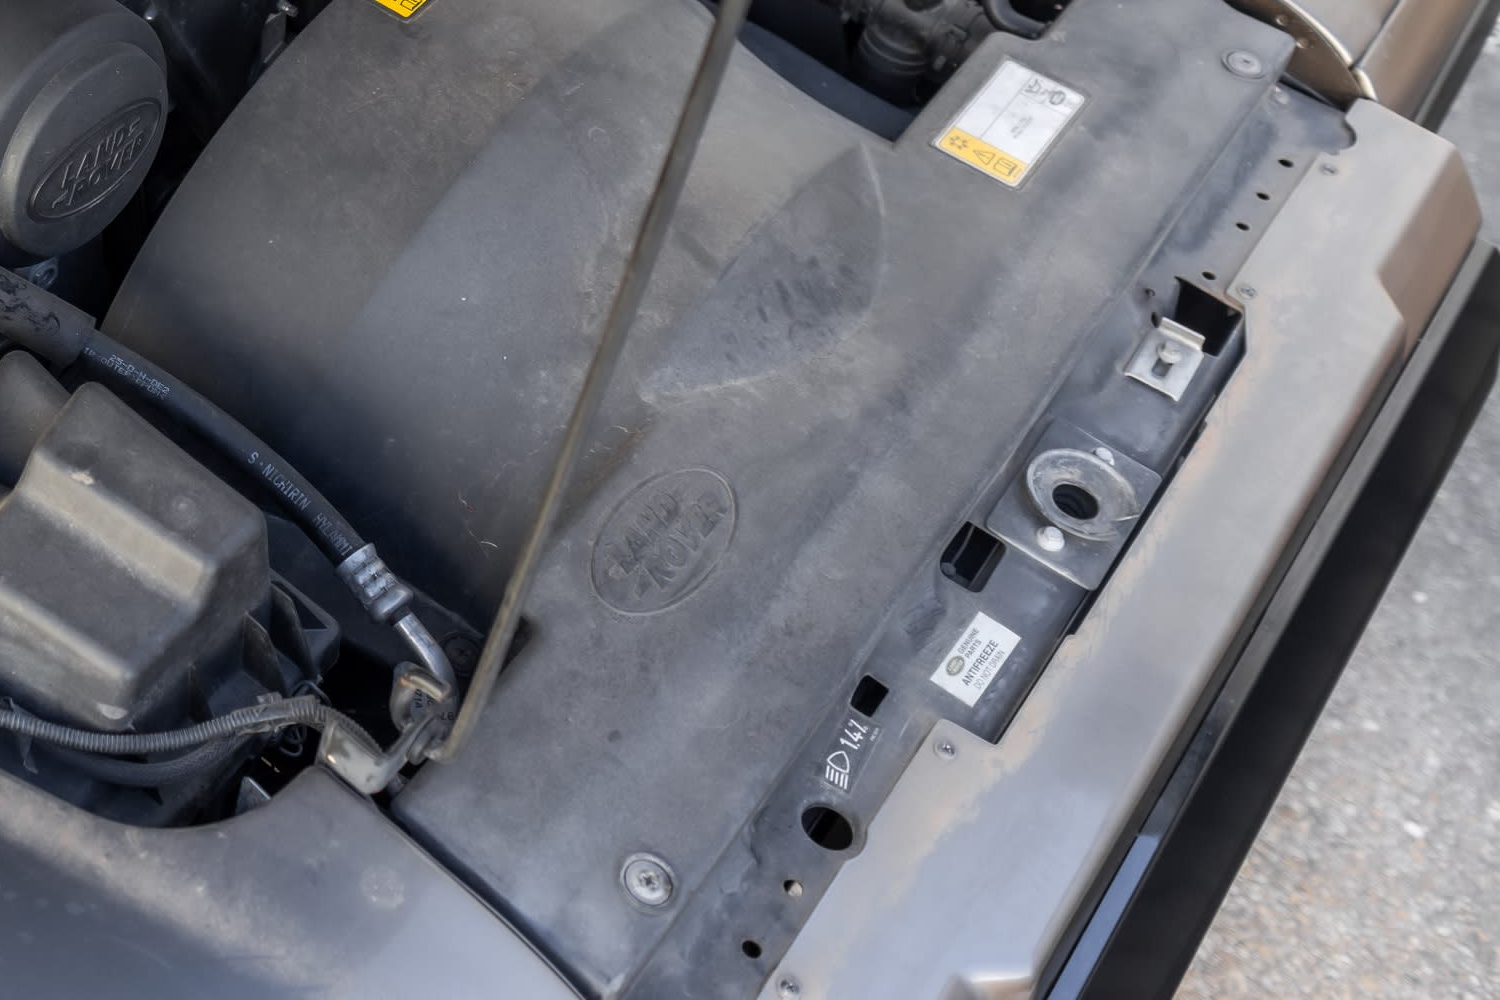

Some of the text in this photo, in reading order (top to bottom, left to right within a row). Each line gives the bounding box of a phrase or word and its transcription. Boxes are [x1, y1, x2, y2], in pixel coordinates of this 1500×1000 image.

[614, 491, 679, 576] LAND
[961, 639, 999, 686] ANTIFREEZE
[964, 639, 982, 659] PARTS
